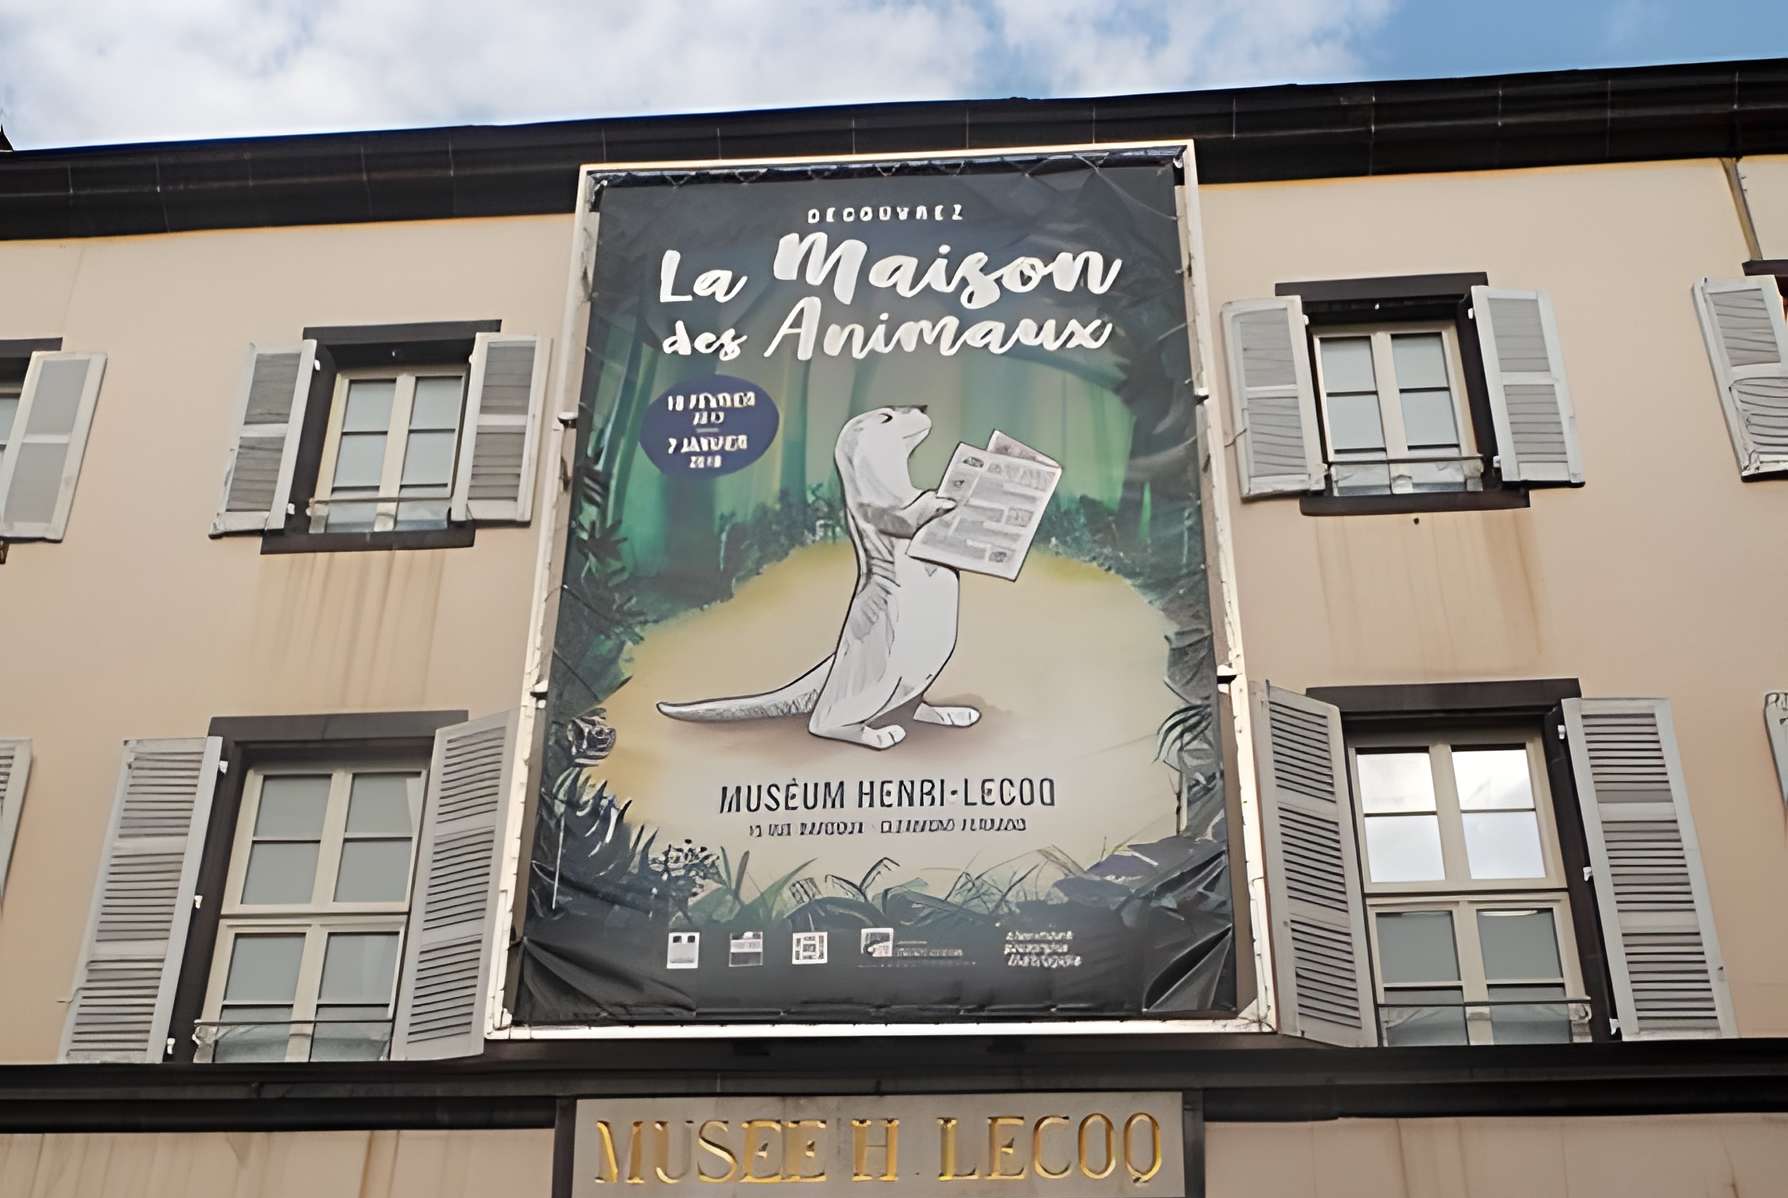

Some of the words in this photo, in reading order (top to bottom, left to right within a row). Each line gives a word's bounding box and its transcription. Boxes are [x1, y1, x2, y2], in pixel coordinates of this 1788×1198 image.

[659, 249, 748, 303] La
[773, 231, 1123, 310] Maison
[662, 319, 748, 361] des
[763, 296, 1113, 361] Animaux
[595, 1118, 827, 1185] MUSEE
[936, 1112, 1163, 1185] LECOQ
